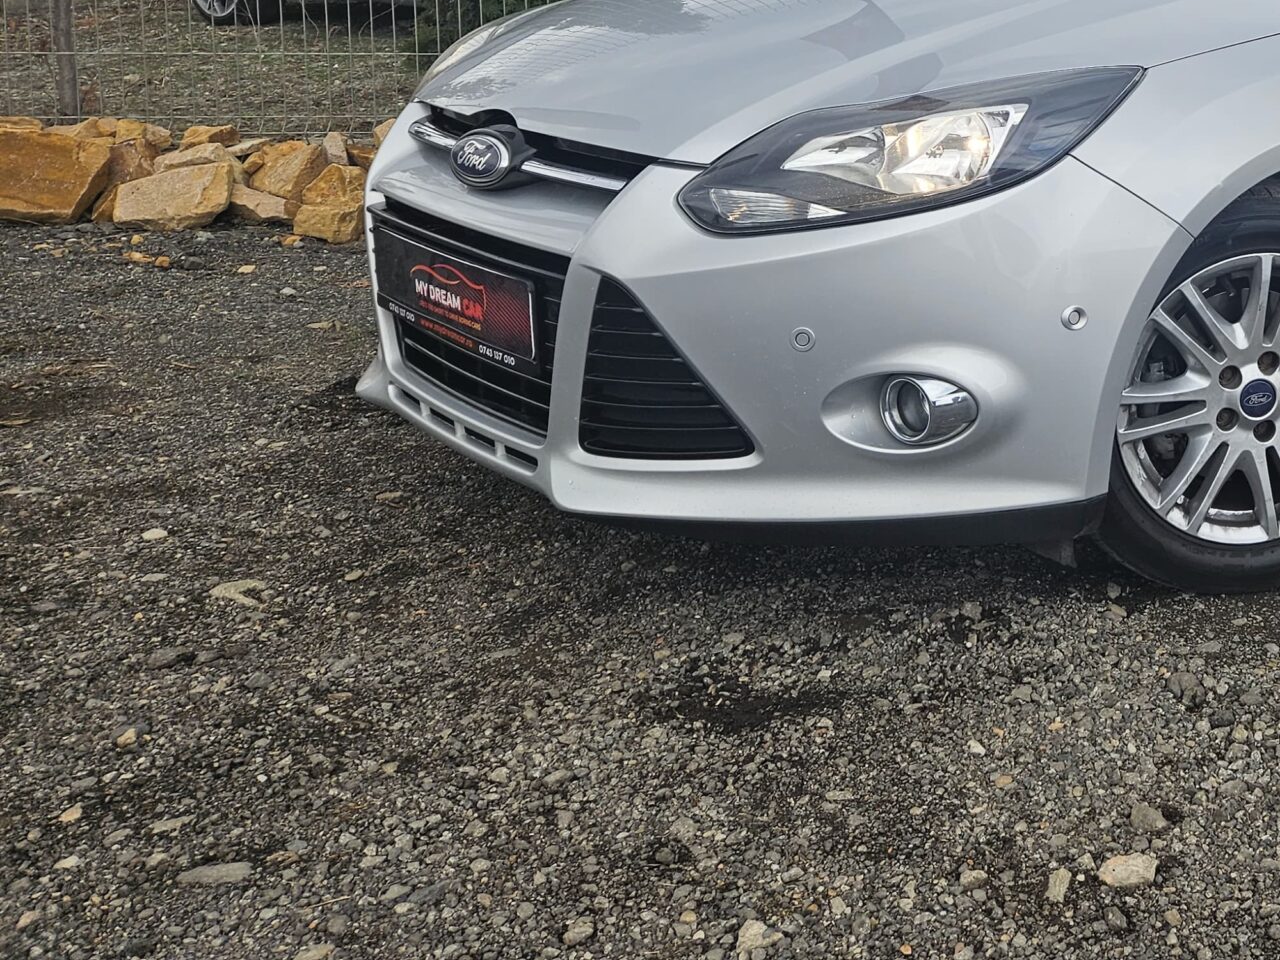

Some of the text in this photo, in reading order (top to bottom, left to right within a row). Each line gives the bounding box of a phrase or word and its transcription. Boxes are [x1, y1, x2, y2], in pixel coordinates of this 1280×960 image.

[457, 140, 491, 171] Ford
[415, 278, 428, 296] MY
[429, 284, 461, 311] DREAM
[1249, 394, 1268, 405] Ford
